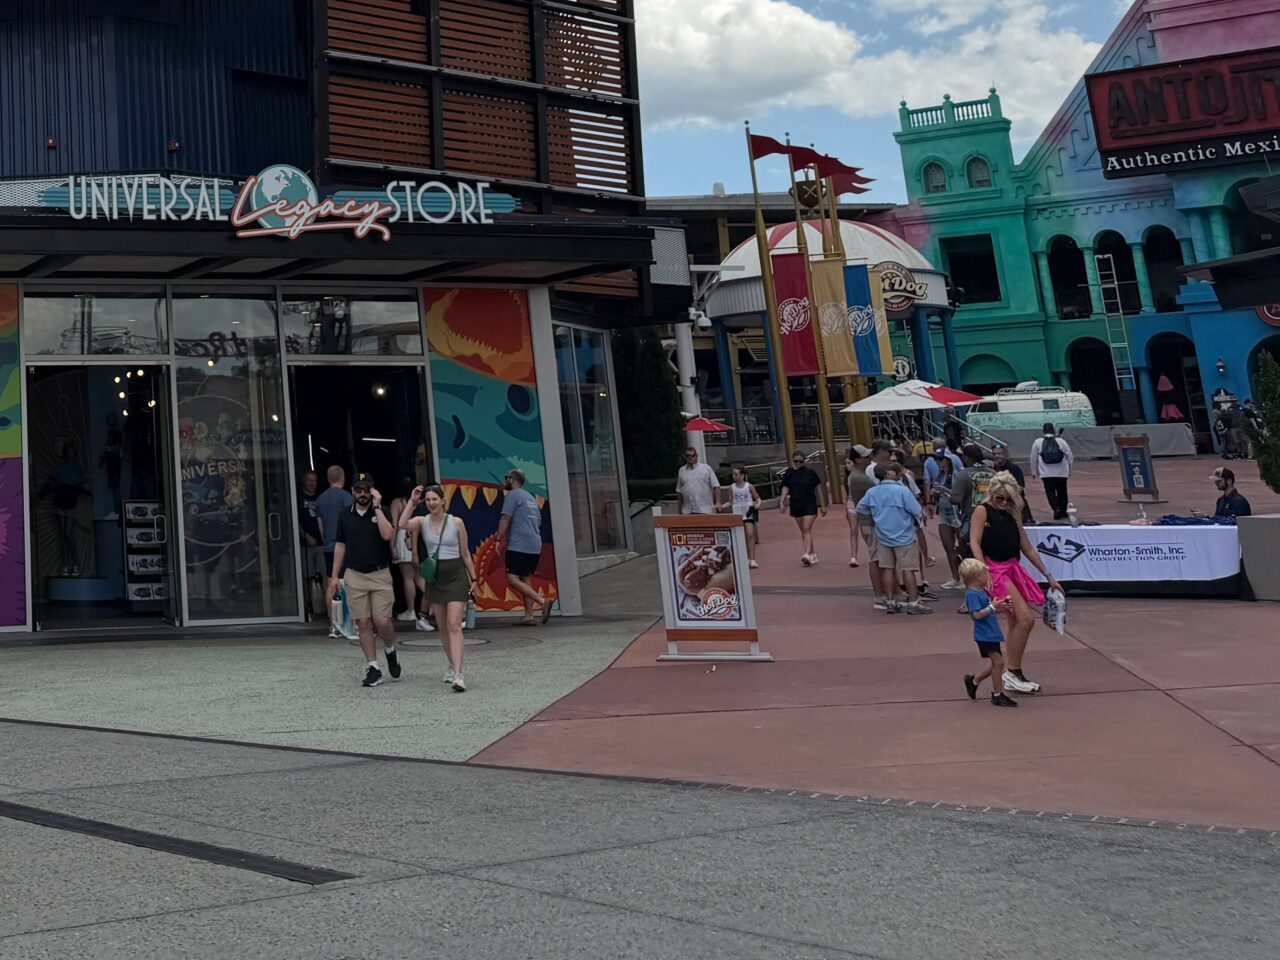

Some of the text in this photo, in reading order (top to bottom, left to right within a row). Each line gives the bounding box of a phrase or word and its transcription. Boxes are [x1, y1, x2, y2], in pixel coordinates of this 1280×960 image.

[1106, 145, 1217, 171] Authentic
[68, 174, 495, 240] UNIVERSAL Legacy STORE
[891, 276, 928, 297] Dog
[1087, 546, 1166, 557] Wharton-Smith,
